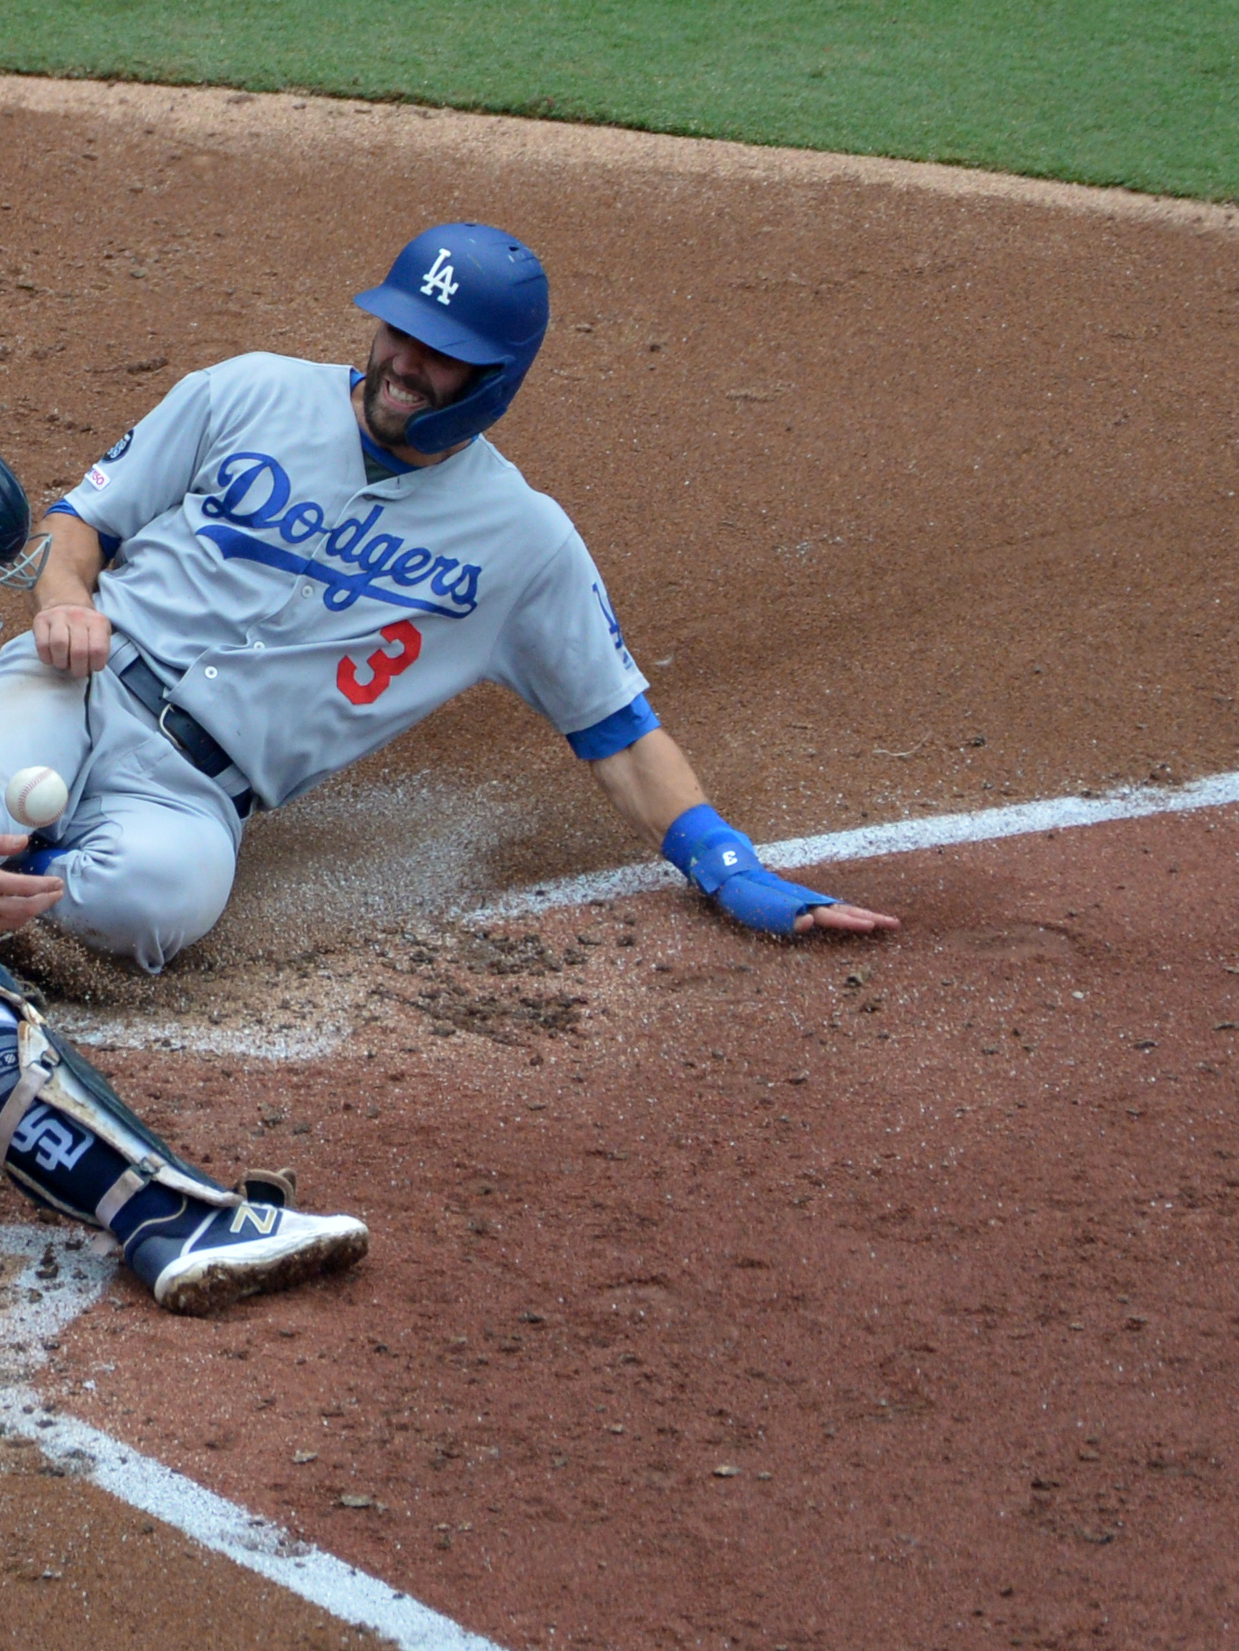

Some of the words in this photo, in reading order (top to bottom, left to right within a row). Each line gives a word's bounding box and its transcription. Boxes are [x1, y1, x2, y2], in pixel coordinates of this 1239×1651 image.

[420, 248, 459, 306] LA
[200, 451, 482, 616] Dodgers
[336, 619, 422, 705] 3
